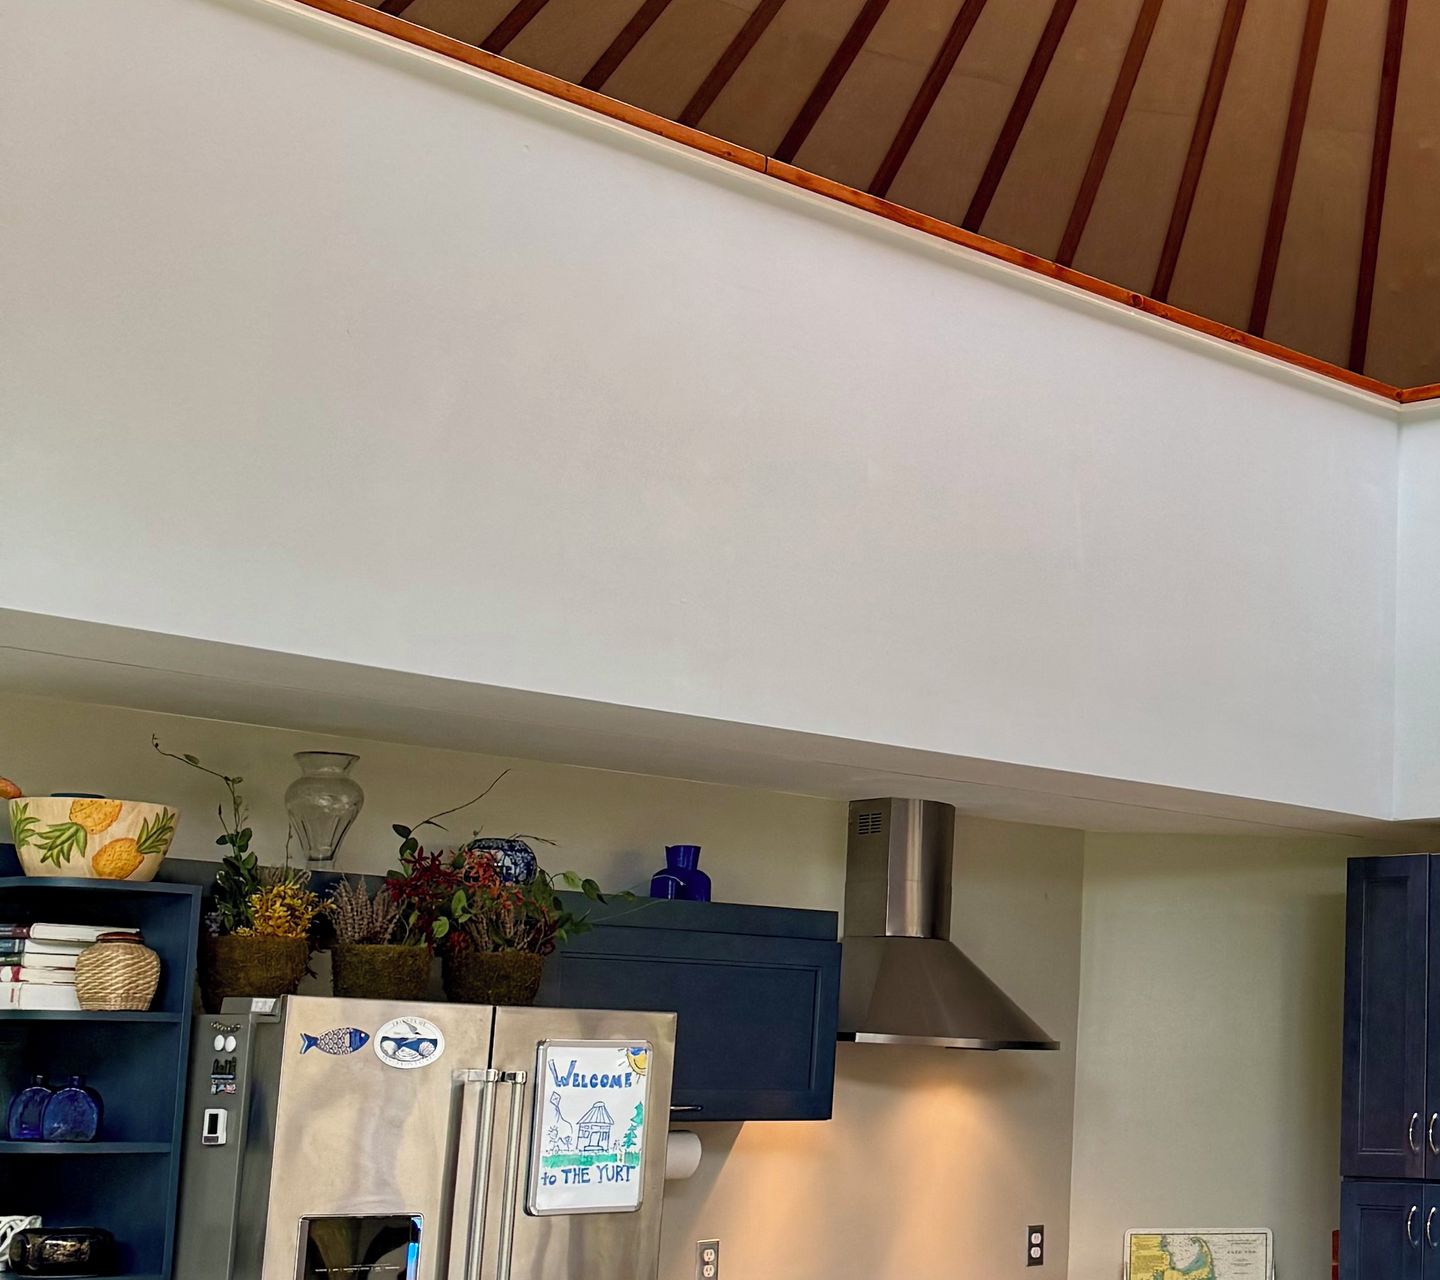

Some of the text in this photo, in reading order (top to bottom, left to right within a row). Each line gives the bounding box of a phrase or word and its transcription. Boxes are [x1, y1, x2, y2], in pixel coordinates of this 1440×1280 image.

[548, 1059, 632, 1089] WELCOME
[541, 1165, 636, 1186] to THE YURT
